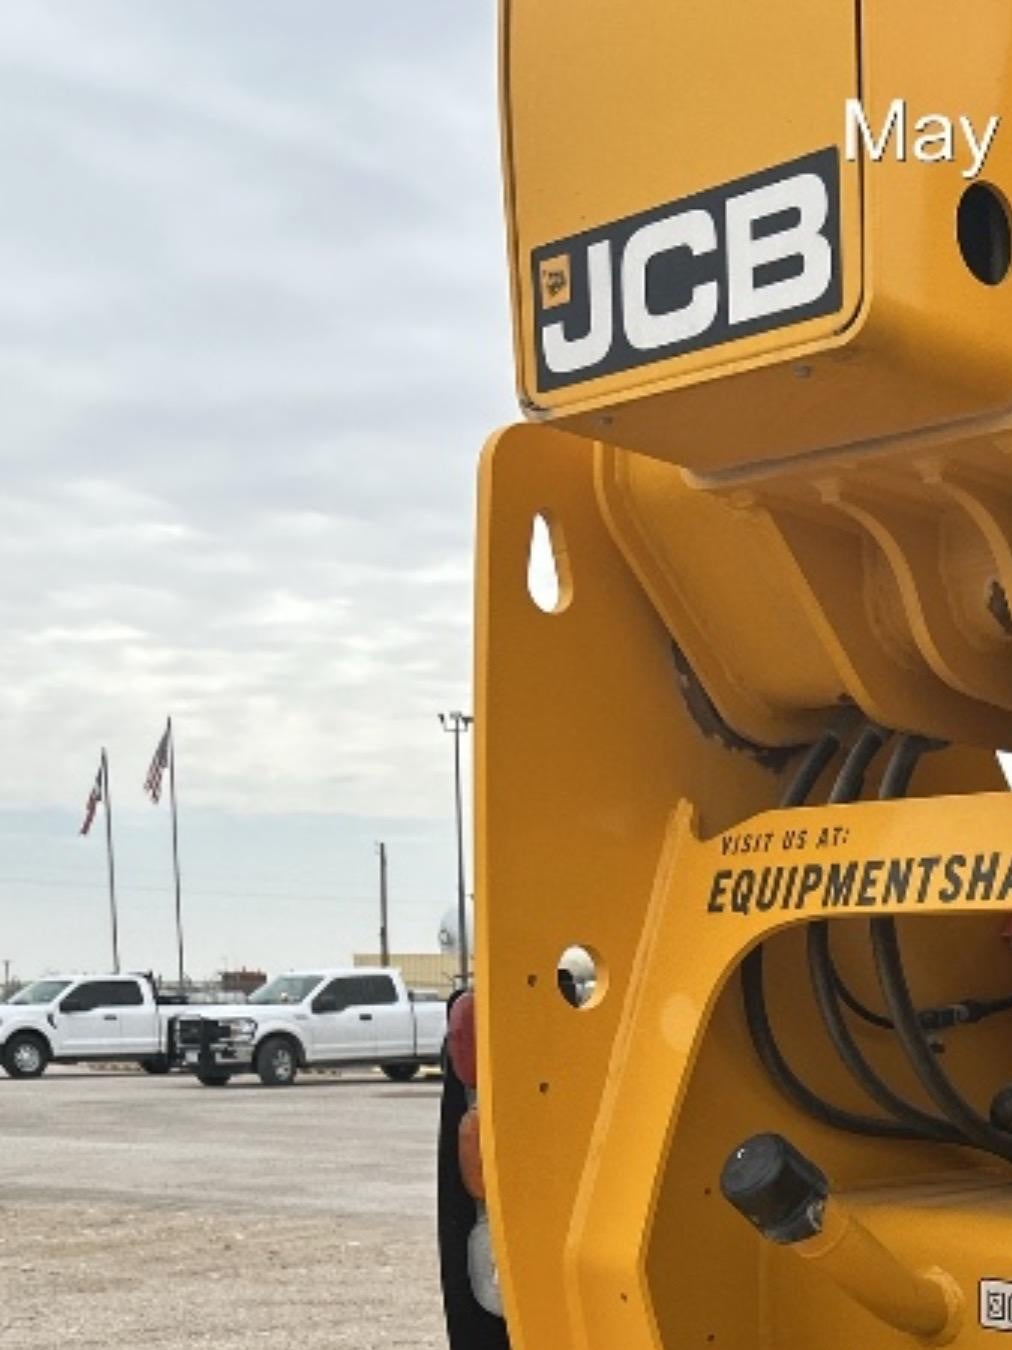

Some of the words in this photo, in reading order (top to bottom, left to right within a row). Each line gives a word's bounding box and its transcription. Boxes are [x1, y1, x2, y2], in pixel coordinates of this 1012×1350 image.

[542, 172, 833, 373] JCB
[721, 831, 774, 856] VISIT
[782, 829, 808, 850] US
[816, 826, 850, 847] AT:
